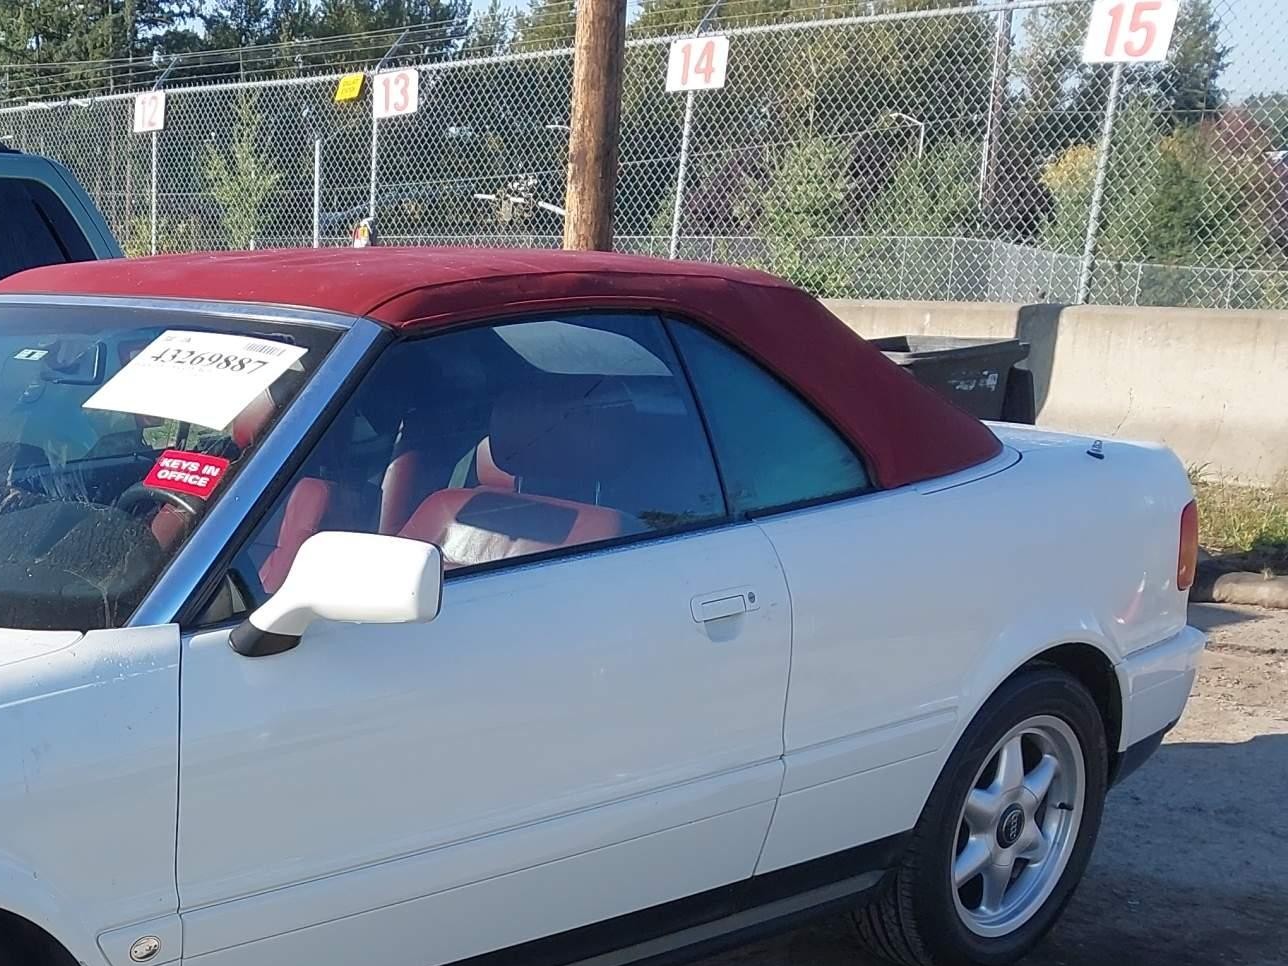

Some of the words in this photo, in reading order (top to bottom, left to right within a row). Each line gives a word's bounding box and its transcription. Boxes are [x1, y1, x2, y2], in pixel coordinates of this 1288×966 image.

[1103, 1, 1162, 58] 15
[680, 41, 716, 85] 14
[381, 75, 410, 114] 13
[140, 96, 159, 127] 12
[150, 348, 269, 375] 43269887
[156, 469, 210, 487] OFFICE
[159, 458, 200, 472] KEYS
[201, 464, 220, 477] IN
